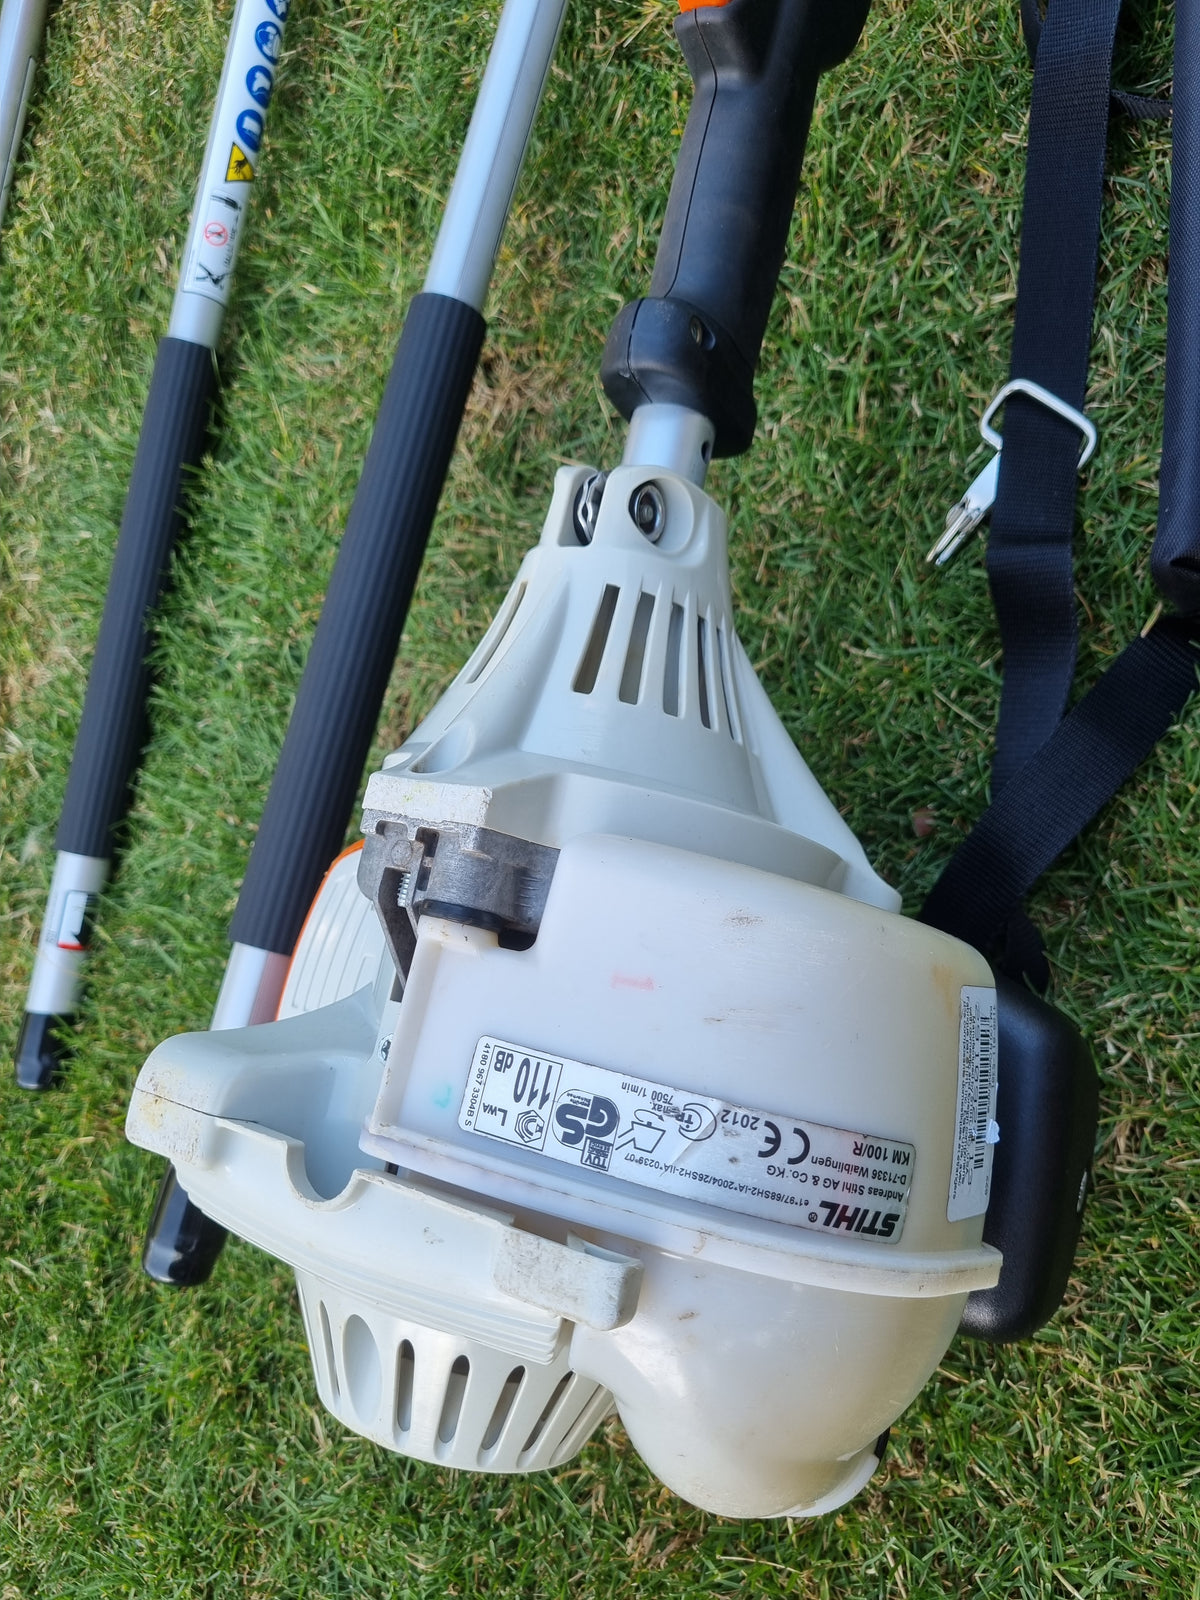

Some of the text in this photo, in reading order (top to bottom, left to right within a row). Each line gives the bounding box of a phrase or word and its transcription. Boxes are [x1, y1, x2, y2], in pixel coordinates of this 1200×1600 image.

[480, 1043, 490, 1065] 4180
[475, 1068, 485, 1085] 967
[494, 1050, 552, 1110] 110 dB
[467, 1087, 480, 1117] 3304B
[621, 1082, 673, 1105] 7500 1/min
[720, 1109, 760, 1130] 2012
[853, 1141, 910, 1166] KM 100/R
[767, 1165, 785, 1178] KG
[811, 1156, 906, 1185] D-71336 Waiblingen
[812, 1175, 820, 1186] &
[823, 1178, 840, 1190] AG
[842, 1181, 865, 1195] Stihl
[868, 1187, 904, 1202] Andreas
